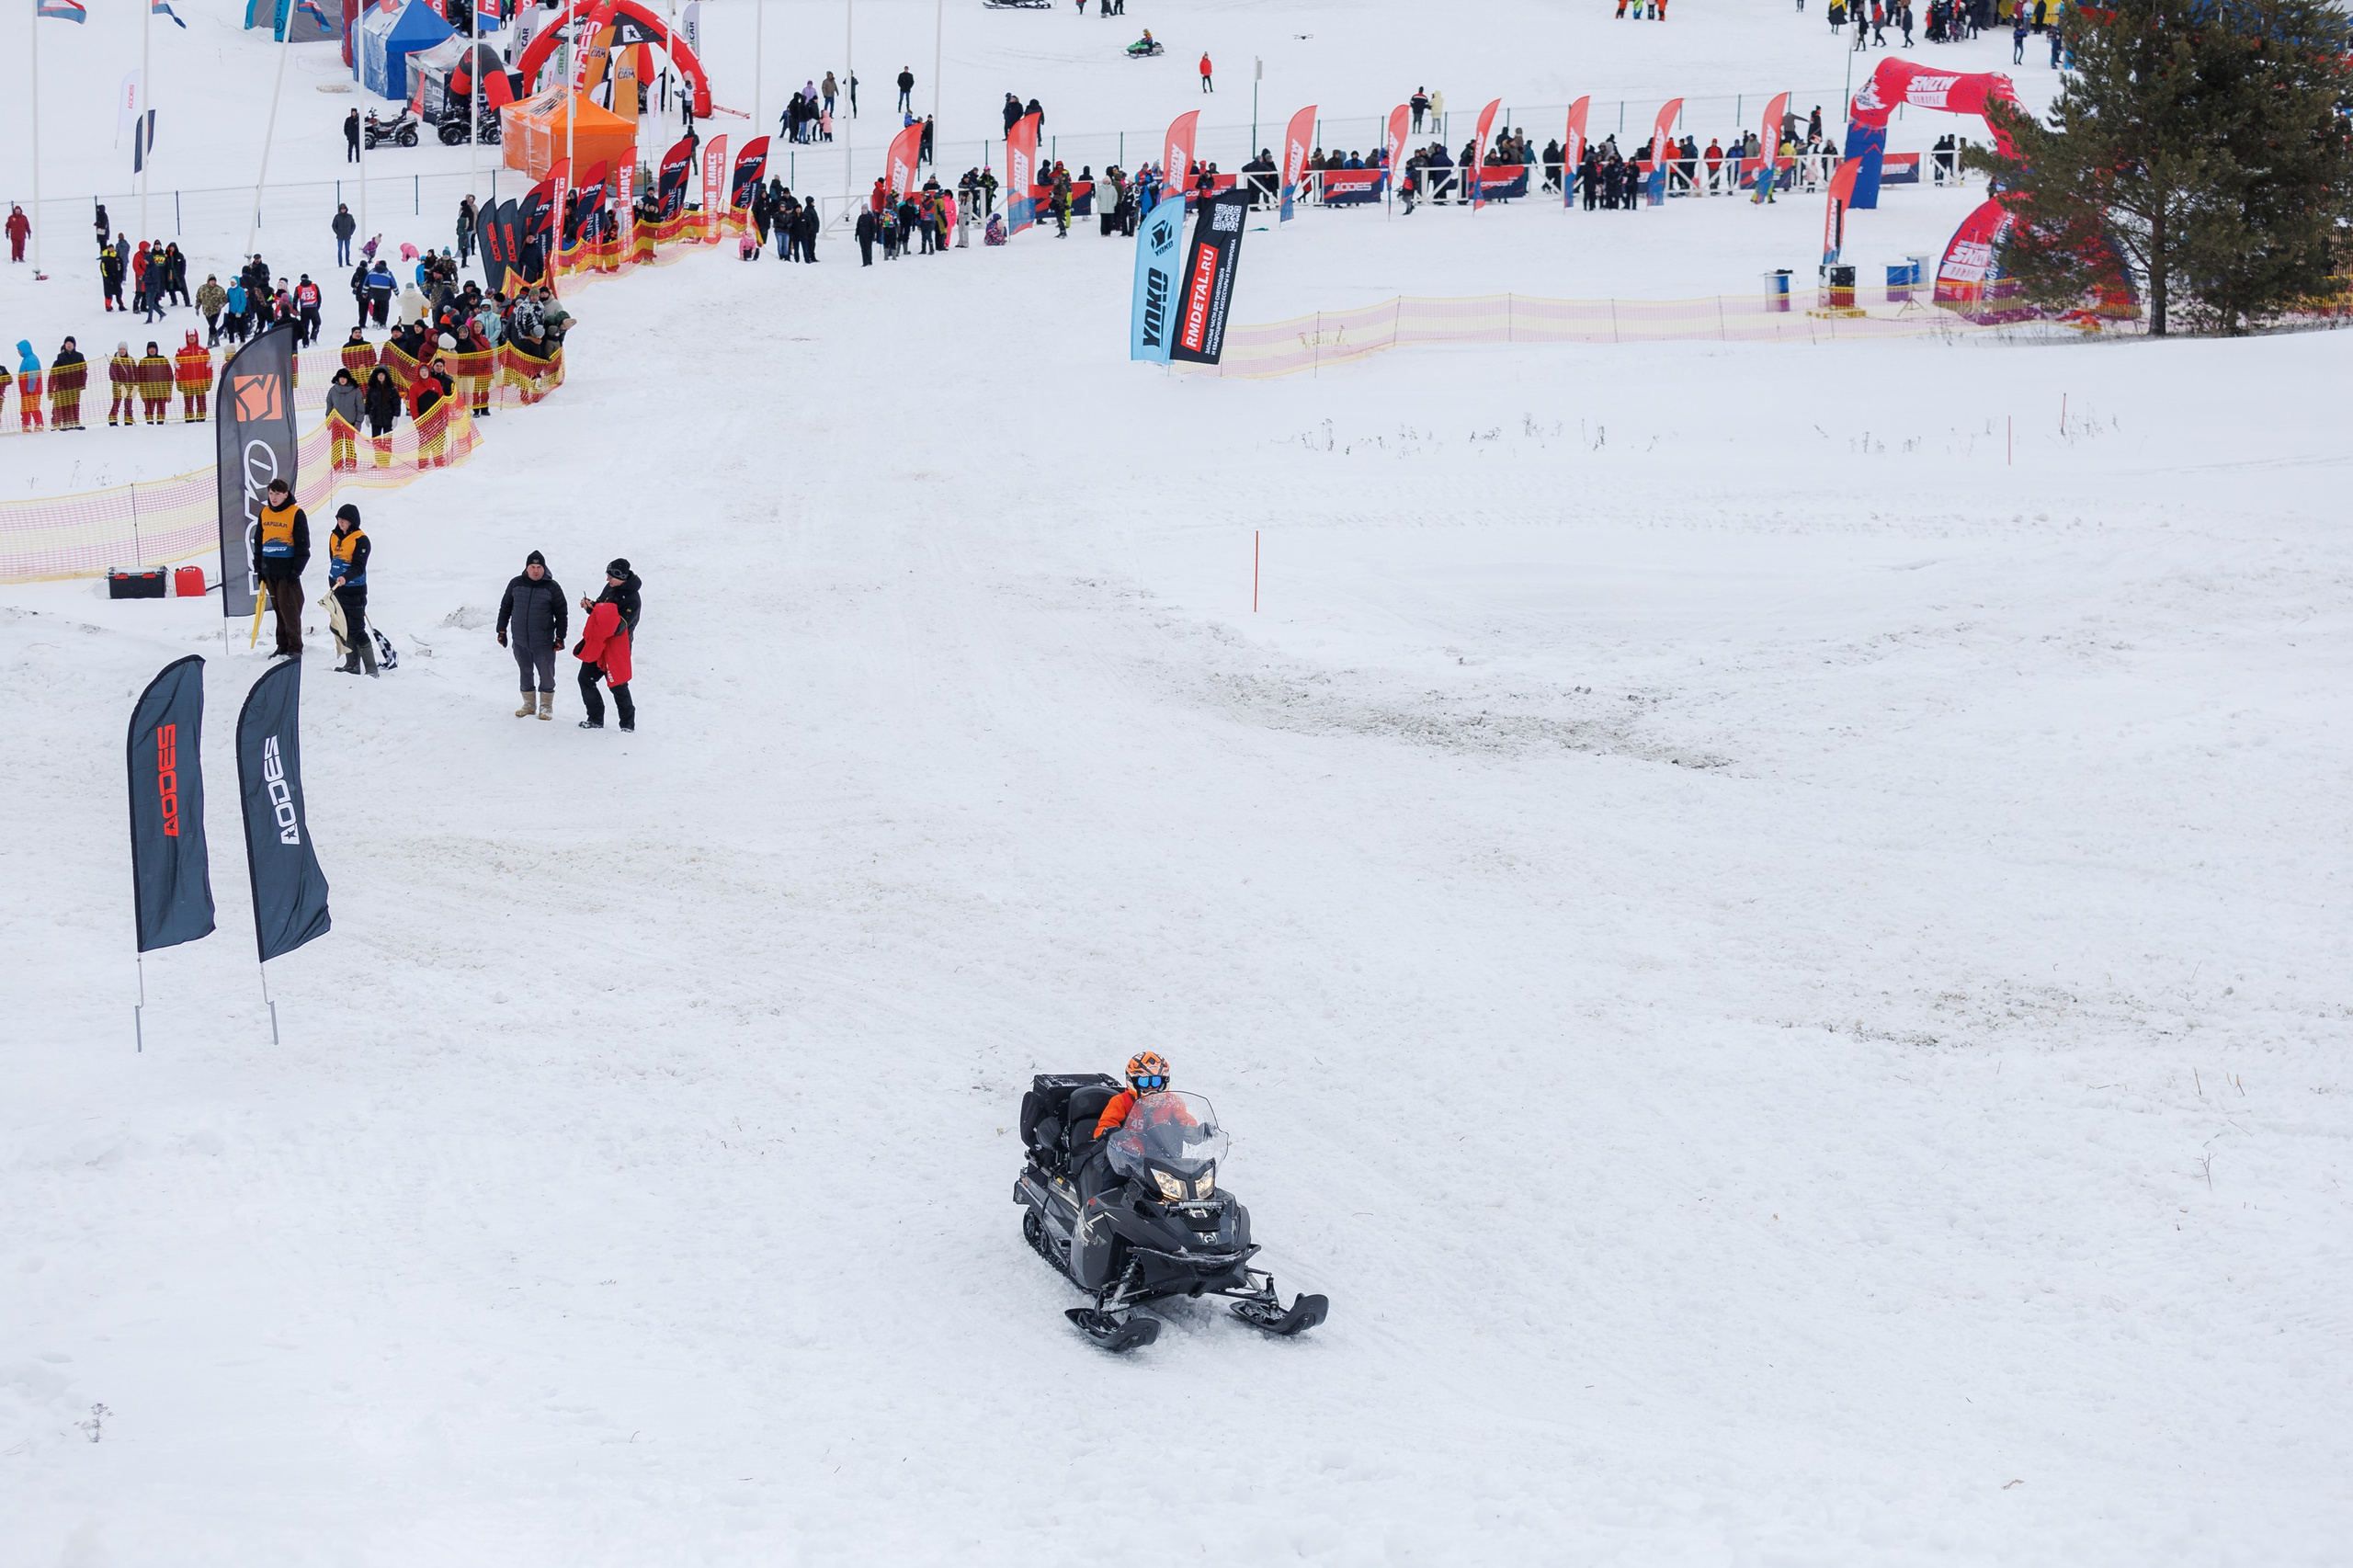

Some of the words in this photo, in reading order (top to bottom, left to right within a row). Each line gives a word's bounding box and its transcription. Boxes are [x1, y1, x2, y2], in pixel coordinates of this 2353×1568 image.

[1906, 75, 1962, 91] SNOW
[663, 160, 687, 170] LAVR
[707, 153, 717, 186] КЛАСС
[738, 156, 763, 165] LAVR
[1014, 148, 1023, 193] SNOW
[1169, 143, 1180, 187] SNOW
[581, 184, 602, 195] LAVR
[1333, 181, 1372, 192] AODES
[1154, 240, 1174, 256] YOKO
[301, 290, 315, 301] 432
[1142, 267, 1168, 348] YOKO
[1186, 248, 1214, 348] RMDETAL.RU
[1205, 328, 1214, 354] ЗАПАСНЫЕ
[1215, 267, 1224, 301] СНЕГОХОДОВ
[1212, 311, 1223, 351] КВАДРОЦИКЛОВ
[1220, 278, 1230, 311] АКСЕССУАРЫ
[1226, 238, 1237, 274] ЭКИПИРОВКА
[157, 723, 178, 837] AODES
[264, 734, 300, 845] AODES
